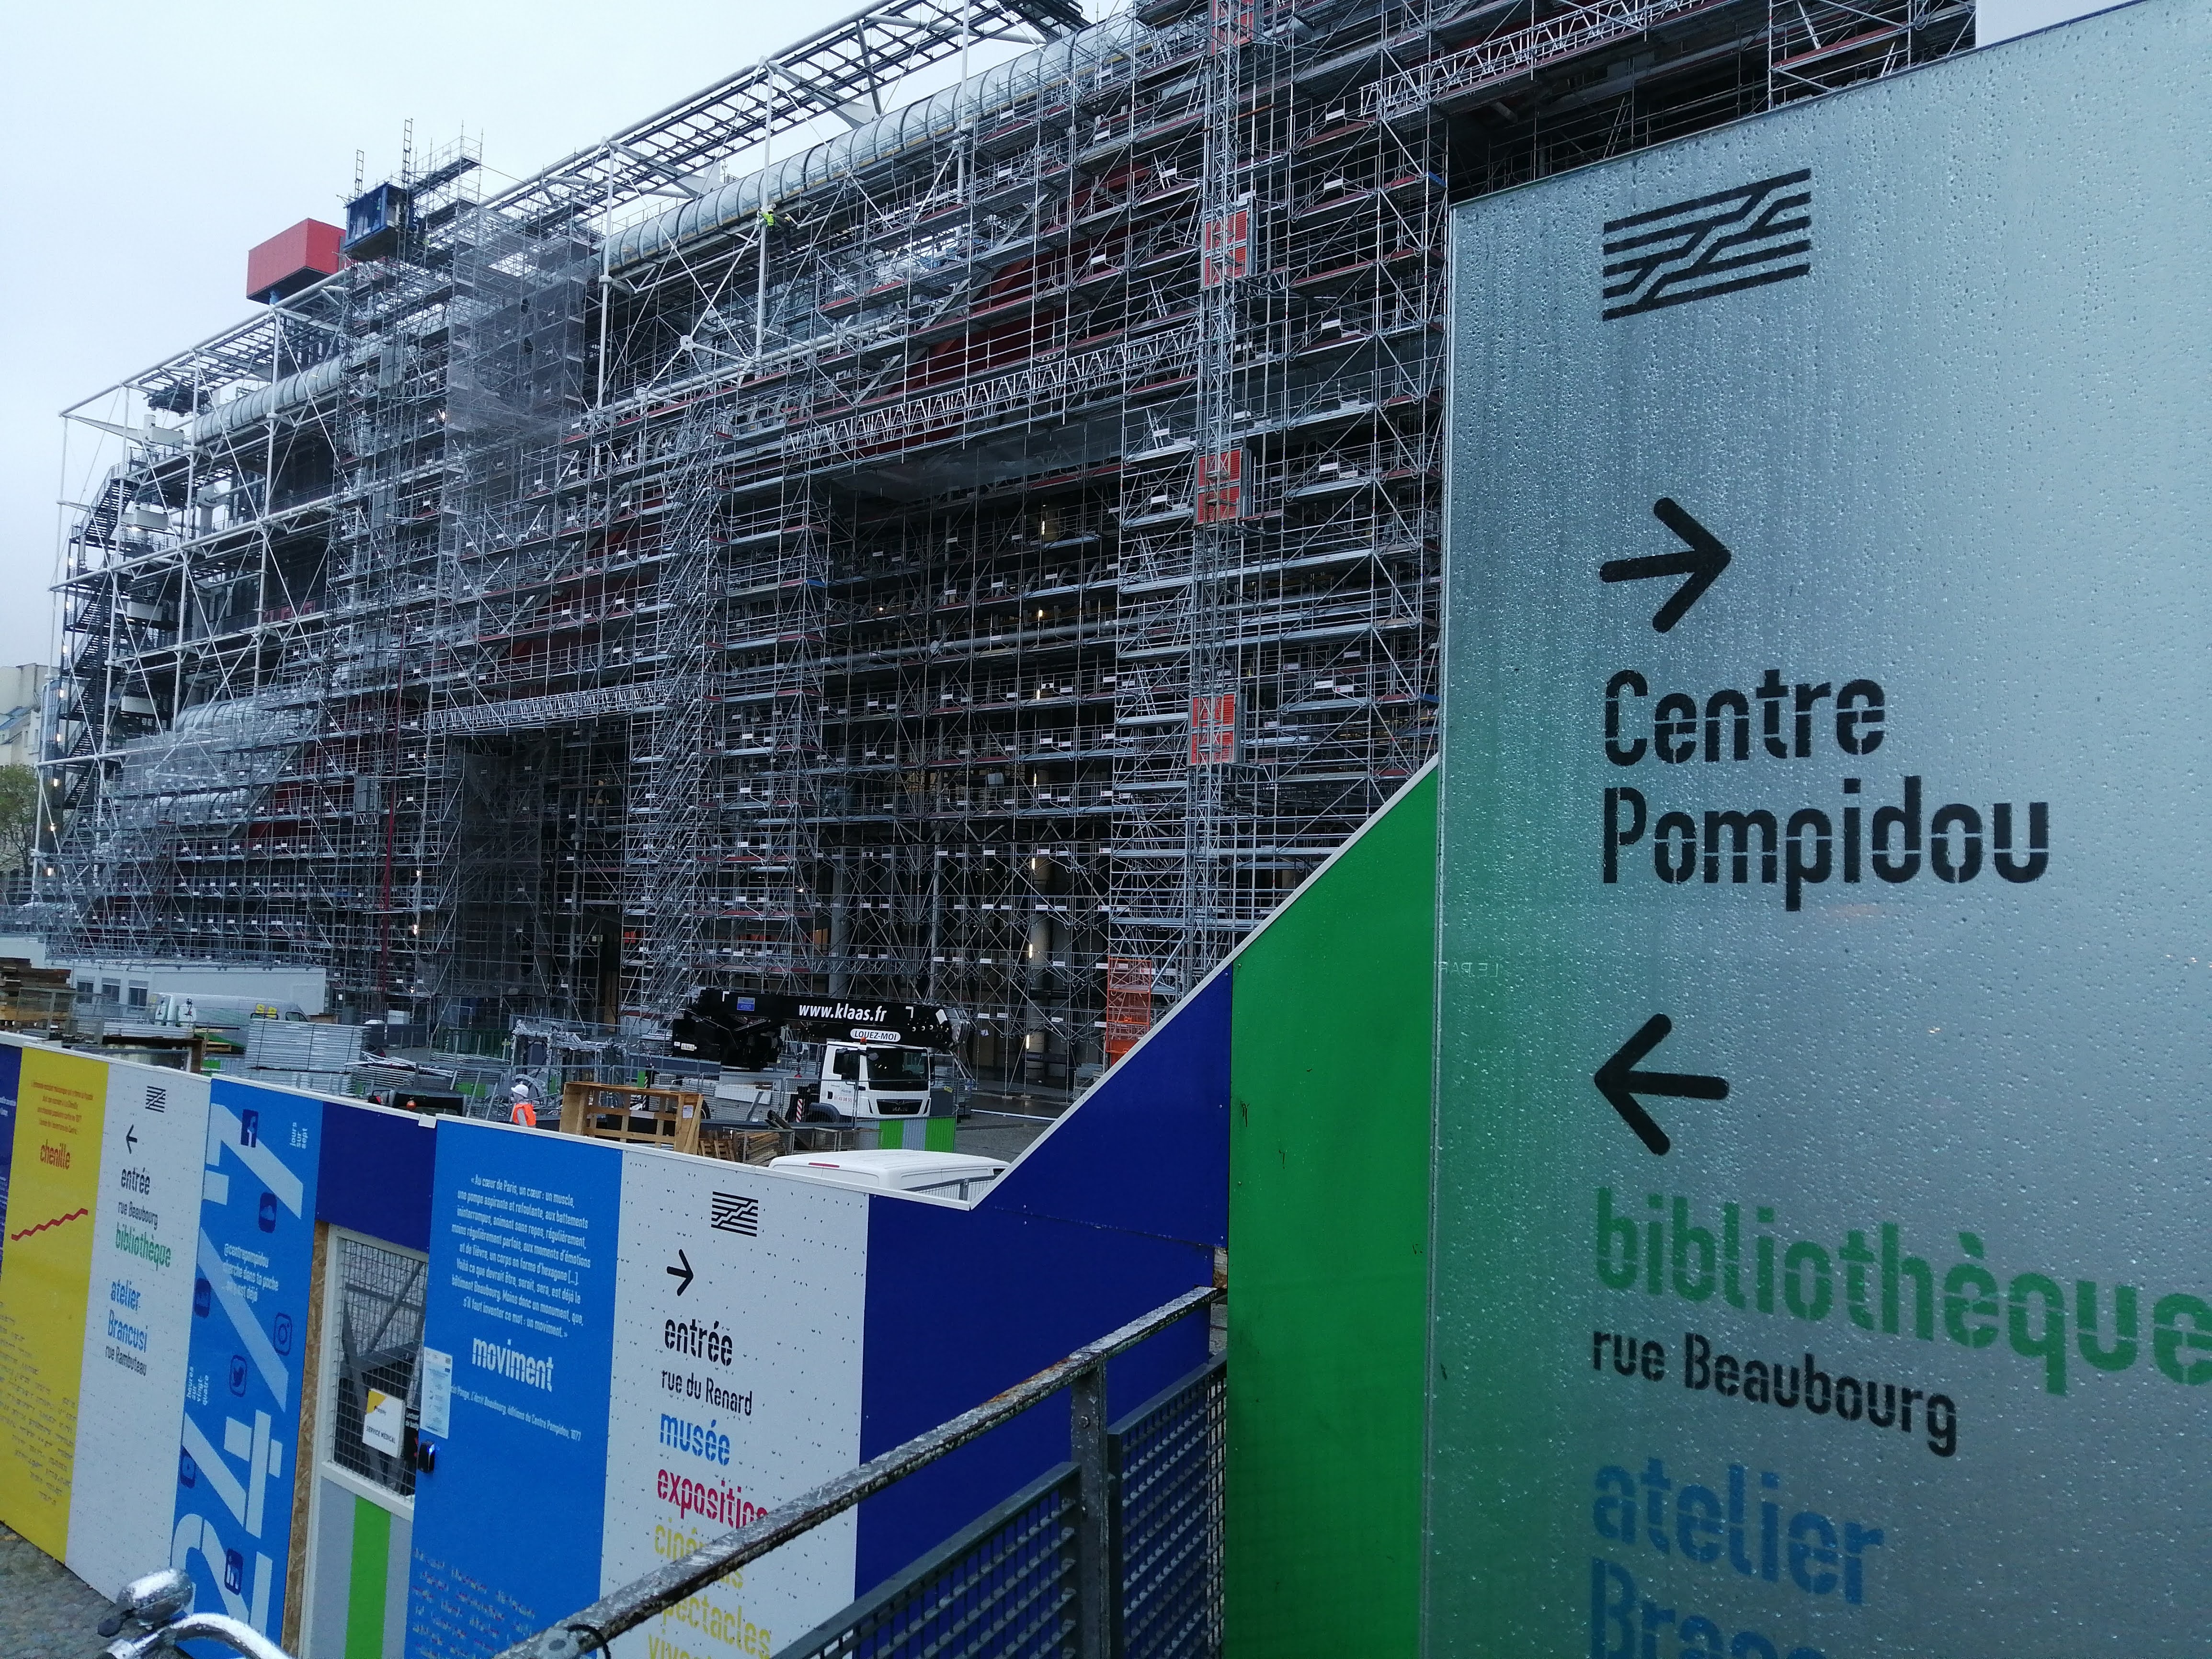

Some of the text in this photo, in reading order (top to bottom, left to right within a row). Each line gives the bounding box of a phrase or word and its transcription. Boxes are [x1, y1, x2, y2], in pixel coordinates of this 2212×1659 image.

[1605, 668, 1885, 767] Centre
[1603, 775, 2050, 912] Pompidou
[799, 1003, 887, 1022] www.klaas.fr
[854, 1031, 897, 1040] LOUEZ-MOI
[40, 1139, 71, 1170] chenille
[121, 1167, 150, 1195] entrée
[497, 1179, 503, 1191] de
[503, 1179, 518, 1195] Paris,
[519, 1186, 526, 1195] un
[546, 1192, 552, 1202] un
[553, 1193, 574, 1208] muscle,
[118, 1201, 159, 1230] rue Beaubourg
[457, 1190, 588, 1229] une pompe aspirante et refoulante, aux battements
[115, 1222, 171, 1271] bibliothèque
[493, 1215, 514, 1230] animant
[515, 1222, 527, 1233] sans
[528, 1226, 545, 1239] repos,
[546, 1227, 586, 1250] régulièrement,
[503, 1236, 522, 1252] parfois,
[524, 1241, 533, 1252] aux
[534, 1244, 559, 1261] moments
[459, 1243, 465, 1252] et
[466, 1243, 472, 1255] de
[497, 1252, 512, 1267] corps
[513, 1258, 519, 1268] en
[520, 1257, 536, 1273] forme
[111, 1279, 141, 1311] atelier
[469, 1264, 475, 1273] ce
[476, 1266, 485, 1278] que
[551, 1286, 560, 1298] est
[562, 1288, 574, 1304] déjà
[575, 1291, 581, 1304] le
[1596, 1186, 2212, 1396] bibliothèque
[504, 1311, 512, 1321] ce
[527, 1318, 534, 1328] un
[532, 1301, 539, 1311] un
[107, 1309, 148, 1353] Brancusi
[665, 1319, 733, 1366] entrée
[105, 1345, 147, 1376] rue Rambuteau
[472, 1337, 554, 1393] moviment
[661, 1370, 753, 1416] rue du Renard
[1593, 1330, 1957, 1457] rue Beaubourg
[366, 1426, 380, 1437] SERVICE
[660, 1413, 730, 1466] musée
[1593, 1456, 1884, 1605] atelier
